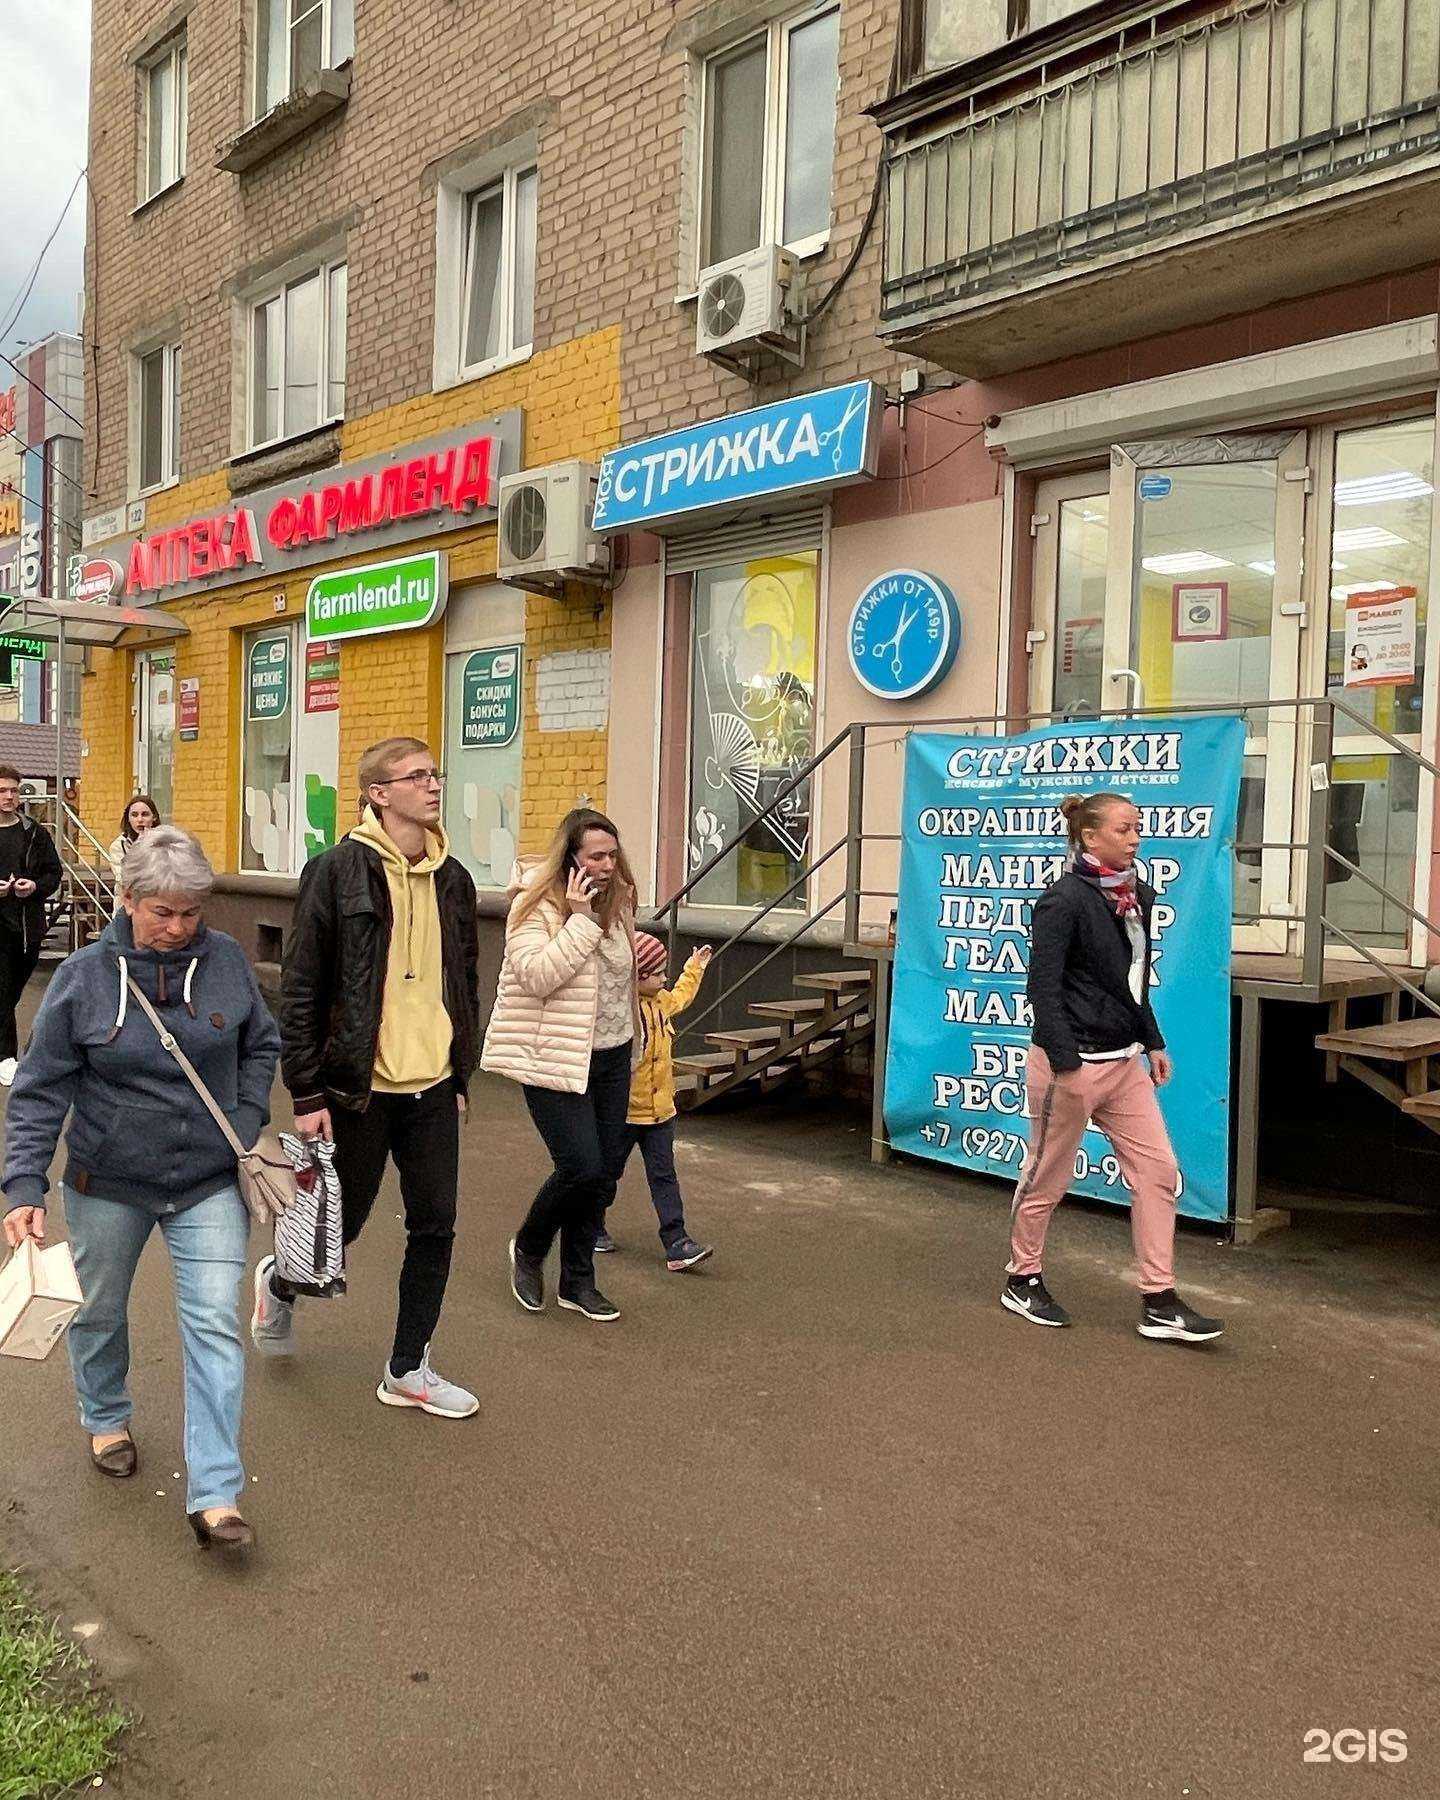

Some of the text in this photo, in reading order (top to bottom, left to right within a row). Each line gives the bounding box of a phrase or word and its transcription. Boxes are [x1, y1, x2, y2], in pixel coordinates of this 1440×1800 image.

[614, 413, 820, 508] СТРИЖКА
[595, 459, 615, 518] МОЯ
[126, 506, 262, 596] АПТЕКА
[266, 435, 502, 548] ФАРМЛЕНД
[313, 574, 431, 621] farmlend.ru
[853, 579, 899, 657] СТРИЖКИ
[902, 579, 926, 599] ОТ
[469, 703, 507, 721] БОНУСЫ
[475, 683, 513, 702] СКИДКИ
[464, 721, 507, 740] ПОДАРКИ
[946, 732, 1184, 779] СТРИЖКИ
[1018, 773, 1094, 790] мужские
[1107, 772, 1180, 786] детские
[917, 805, 1214, 840] ОКРАШИНИЯ
[939, 853, 1182, 895] МАНИР
[919, 1122, 1031, 1171] +7 (927)
